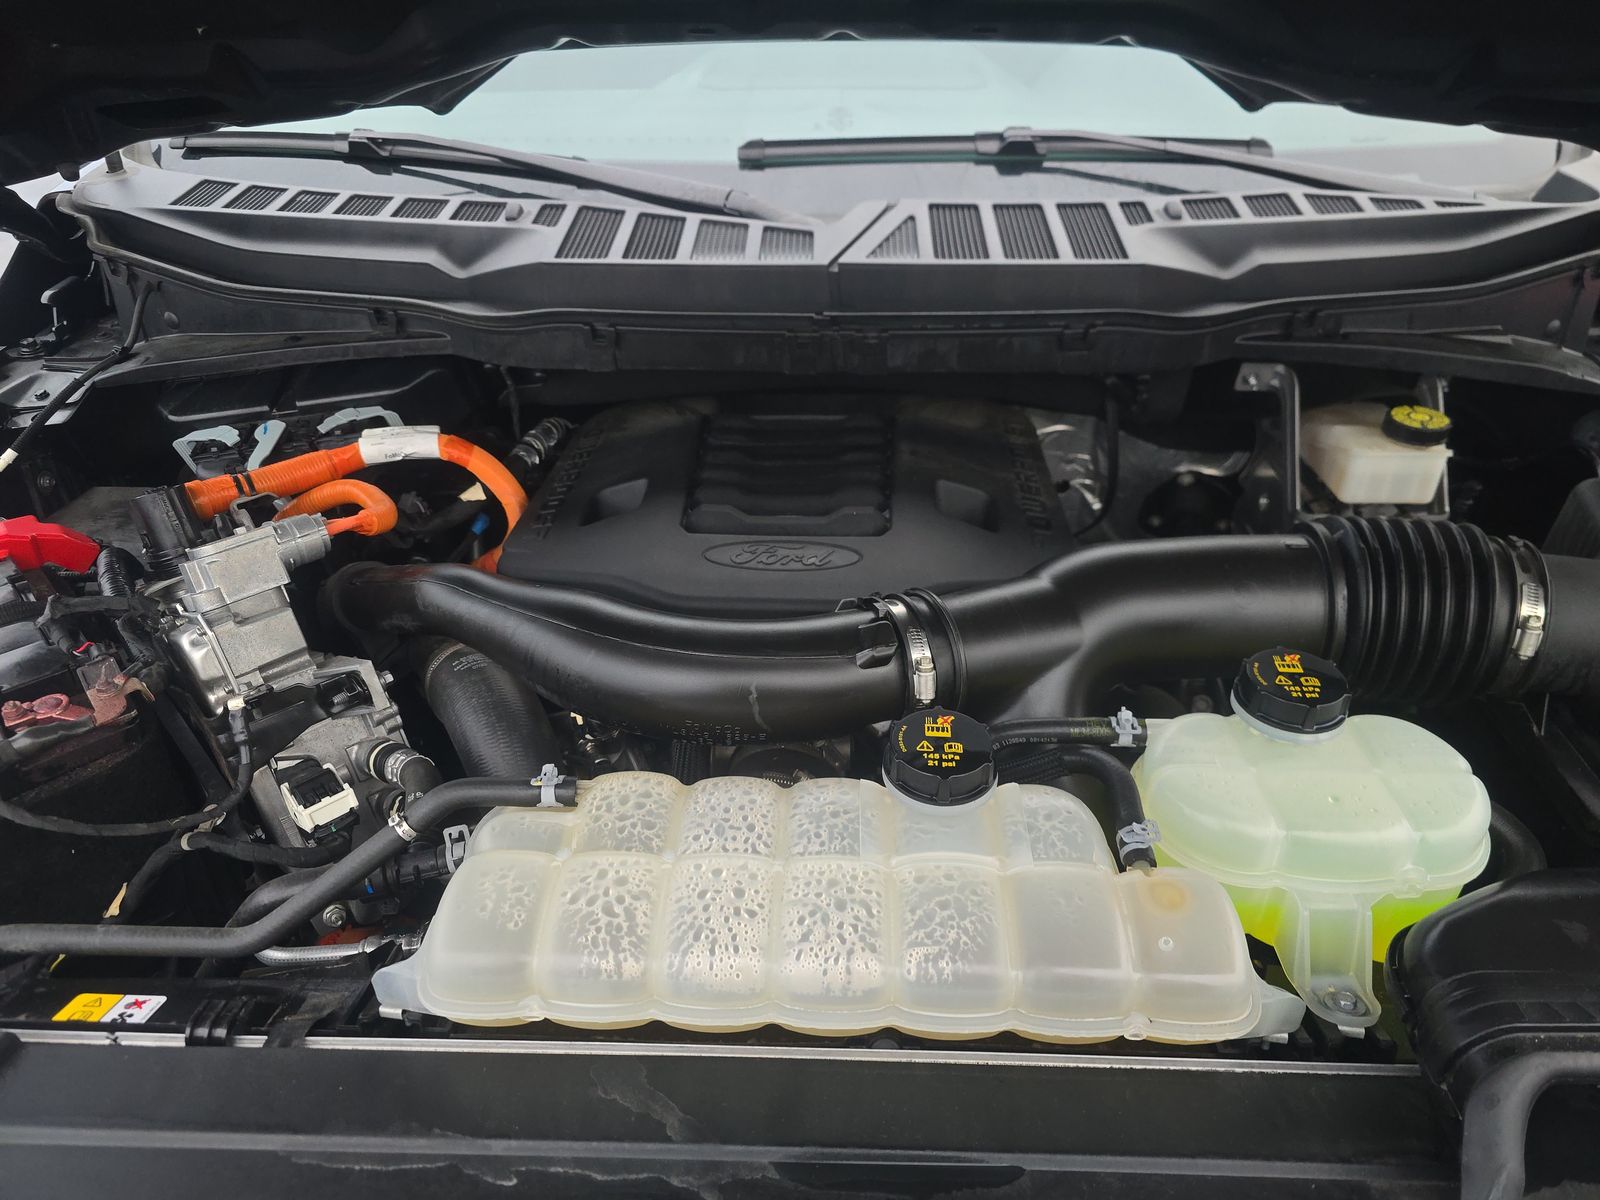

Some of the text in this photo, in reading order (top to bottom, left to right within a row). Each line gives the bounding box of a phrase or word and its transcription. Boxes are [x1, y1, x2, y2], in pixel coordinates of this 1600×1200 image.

[729, 543, 836, 567] Ford
[922, 752, 961, 761] 145 kPa
[942, 760, 956, 768] psi
